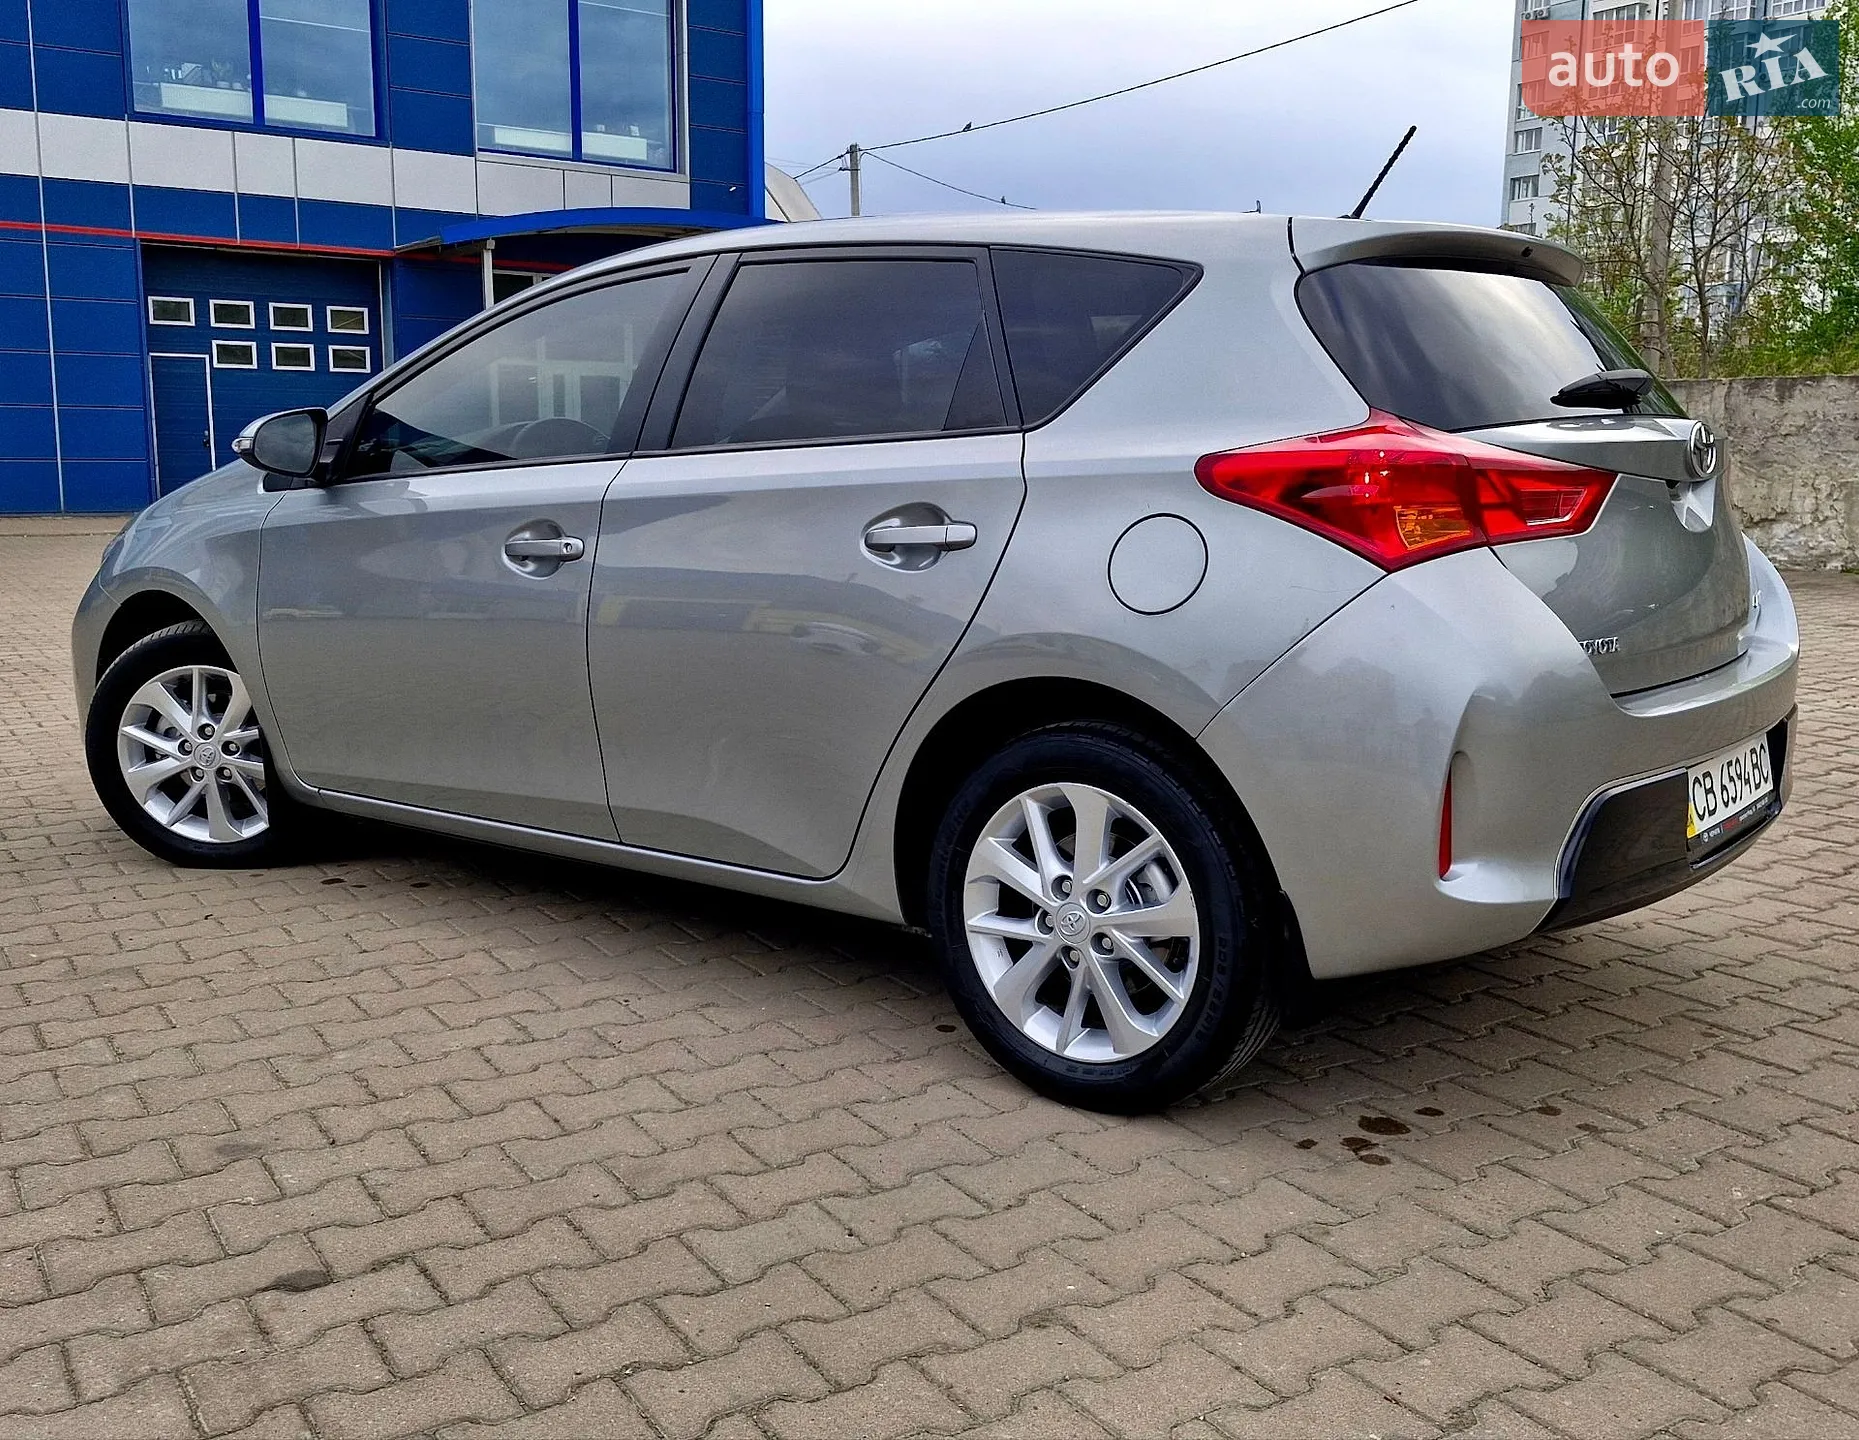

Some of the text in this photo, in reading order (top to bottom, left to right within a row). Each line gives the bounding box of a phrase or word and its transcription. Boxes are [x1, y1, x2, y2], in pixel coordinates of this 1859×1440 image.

[1692, 770, 1718, 821] CB
[1720, 751, 1752, 808] 6594
[1750, 742, 1769, 790] BC
